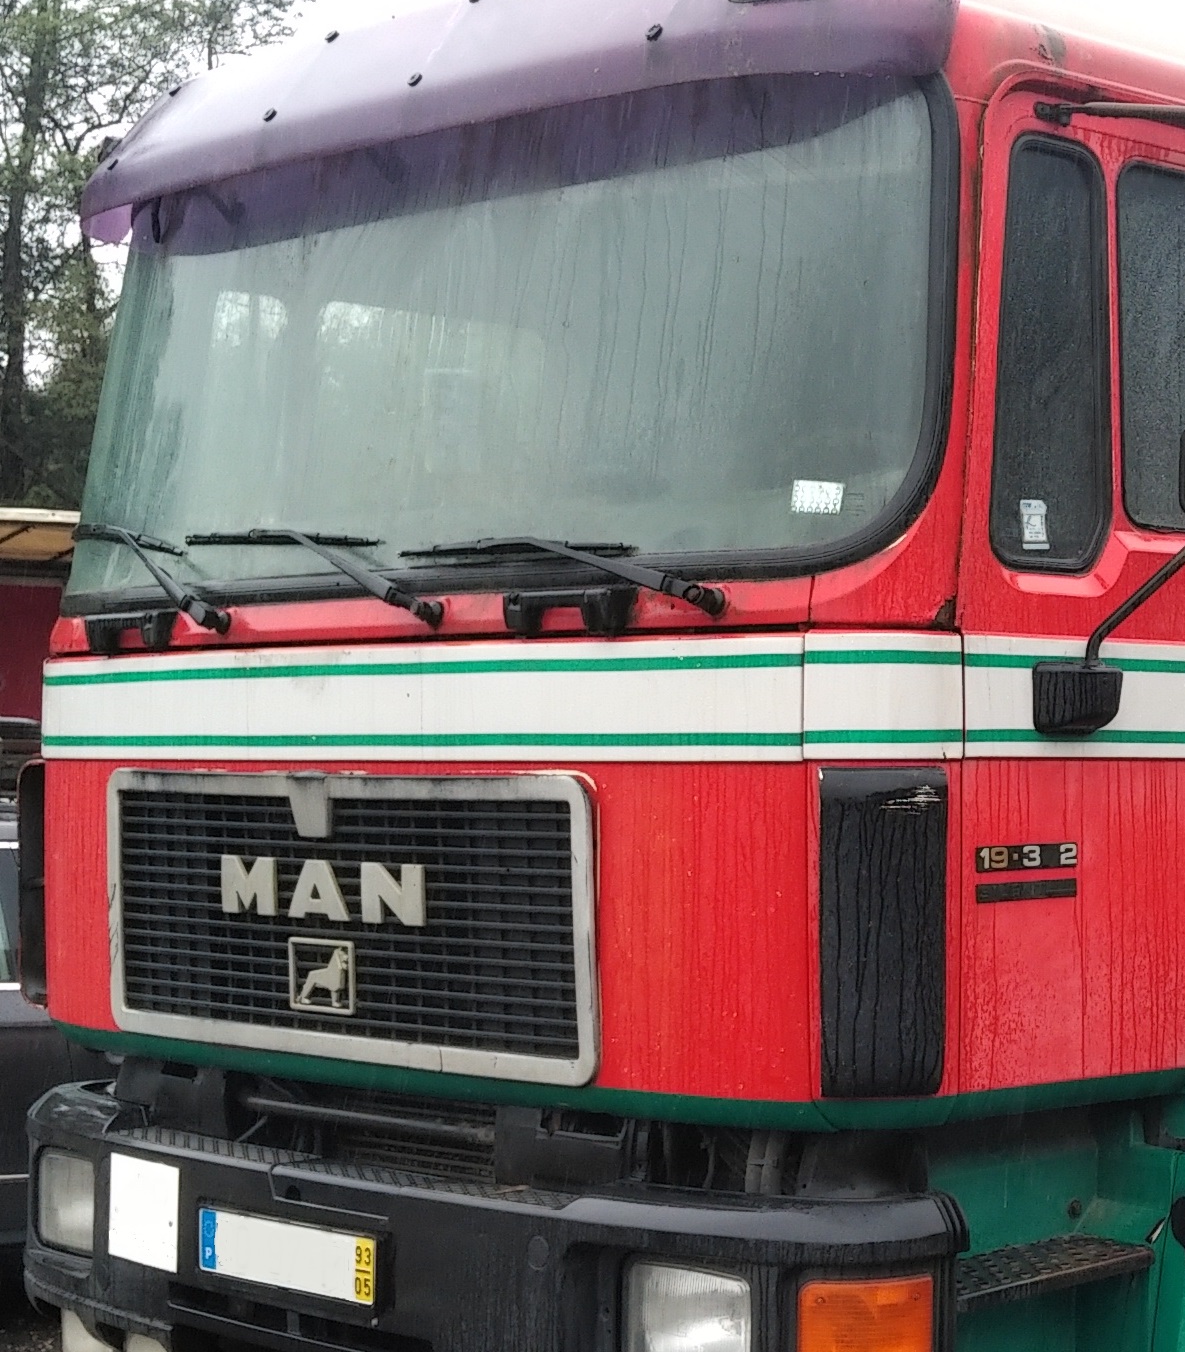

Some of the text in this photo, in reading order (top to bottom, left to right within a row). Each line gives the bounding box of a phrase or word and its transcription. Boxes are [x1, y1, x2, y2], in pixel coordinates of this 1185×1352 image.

[221, 854, 427, 927] MAN
[205, 1247, 213, 1260] P
[355, 1245, 372, 1266] 93
[354, 1276, 371, 1297] 05
